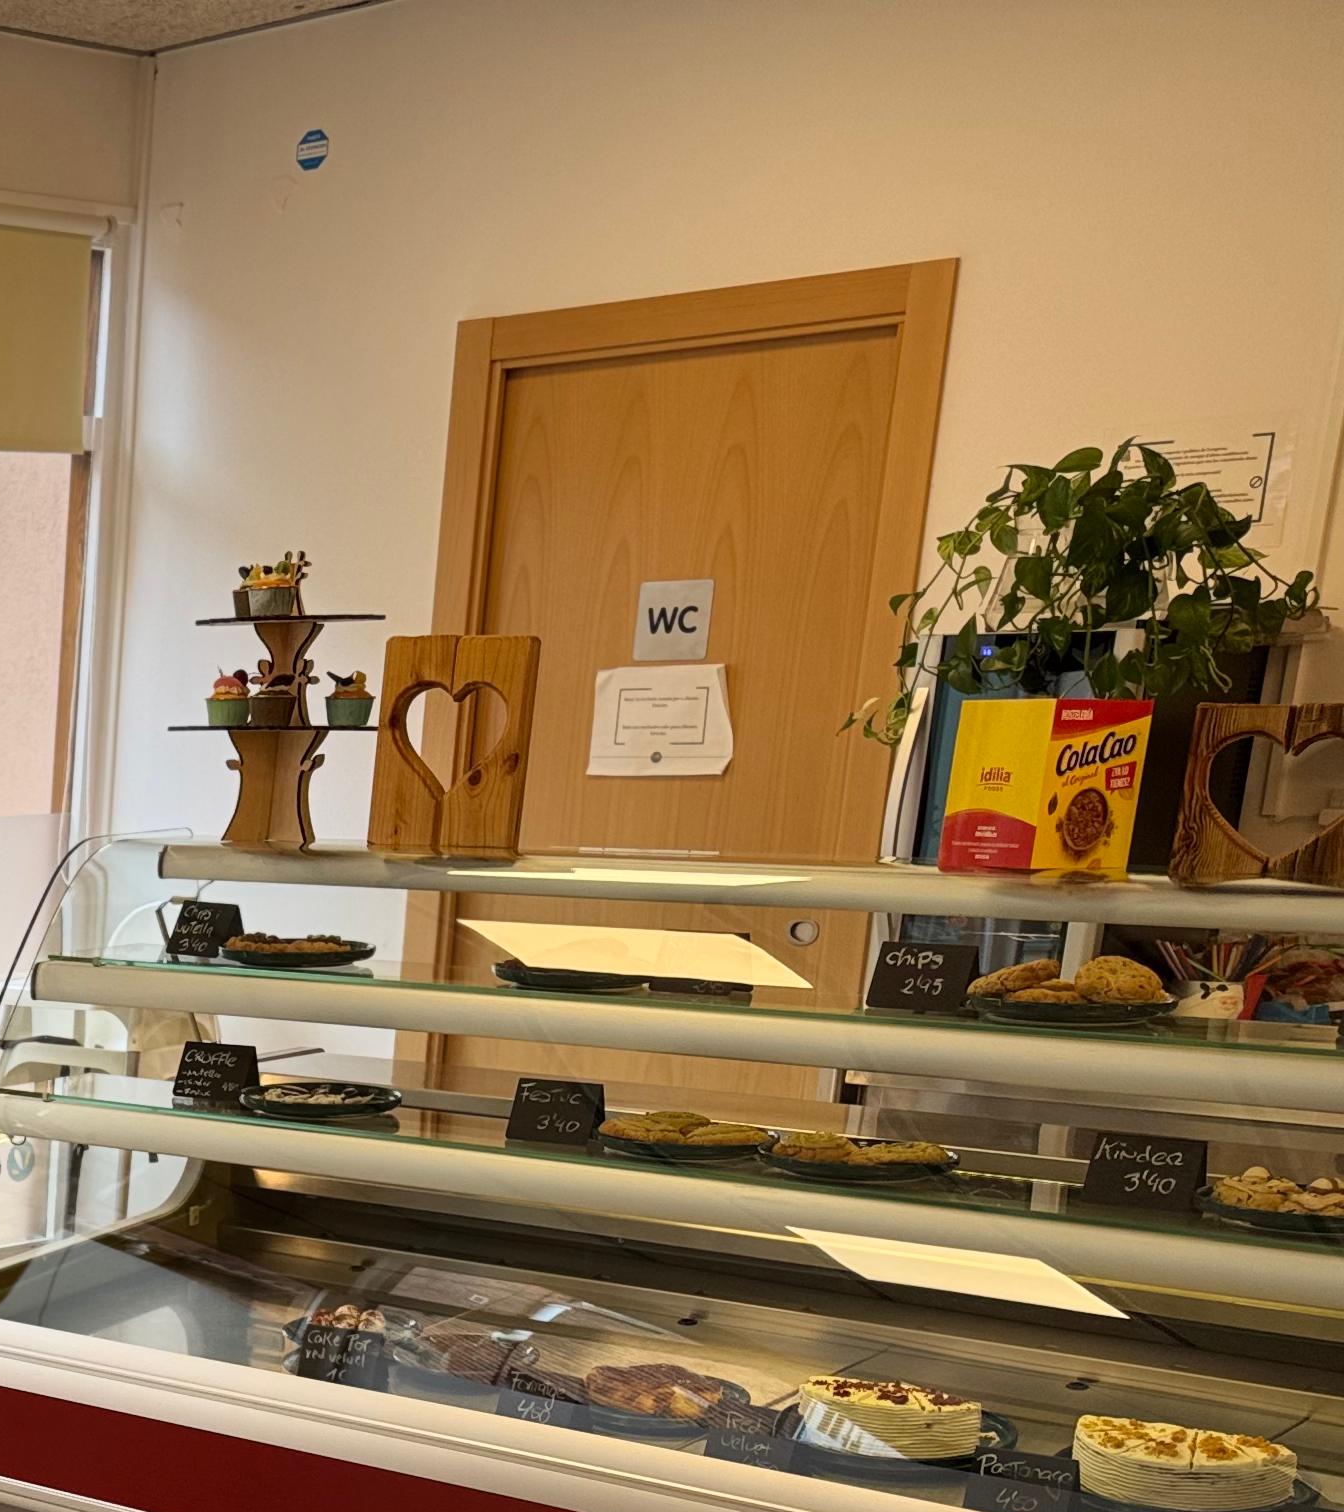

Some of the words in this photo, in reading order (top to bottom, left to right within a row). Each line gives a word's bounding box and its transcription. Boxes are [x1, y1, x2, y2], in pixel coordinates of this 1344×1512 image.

[648, 605, 699, 634] WC
[1056, 731, 1137, 776] ColaCao
[979, 766, 1012, 783] idilia
[536, 1113, 581, 1133] 3'40
[1124, 1169, 1176, 1195] 3'40
